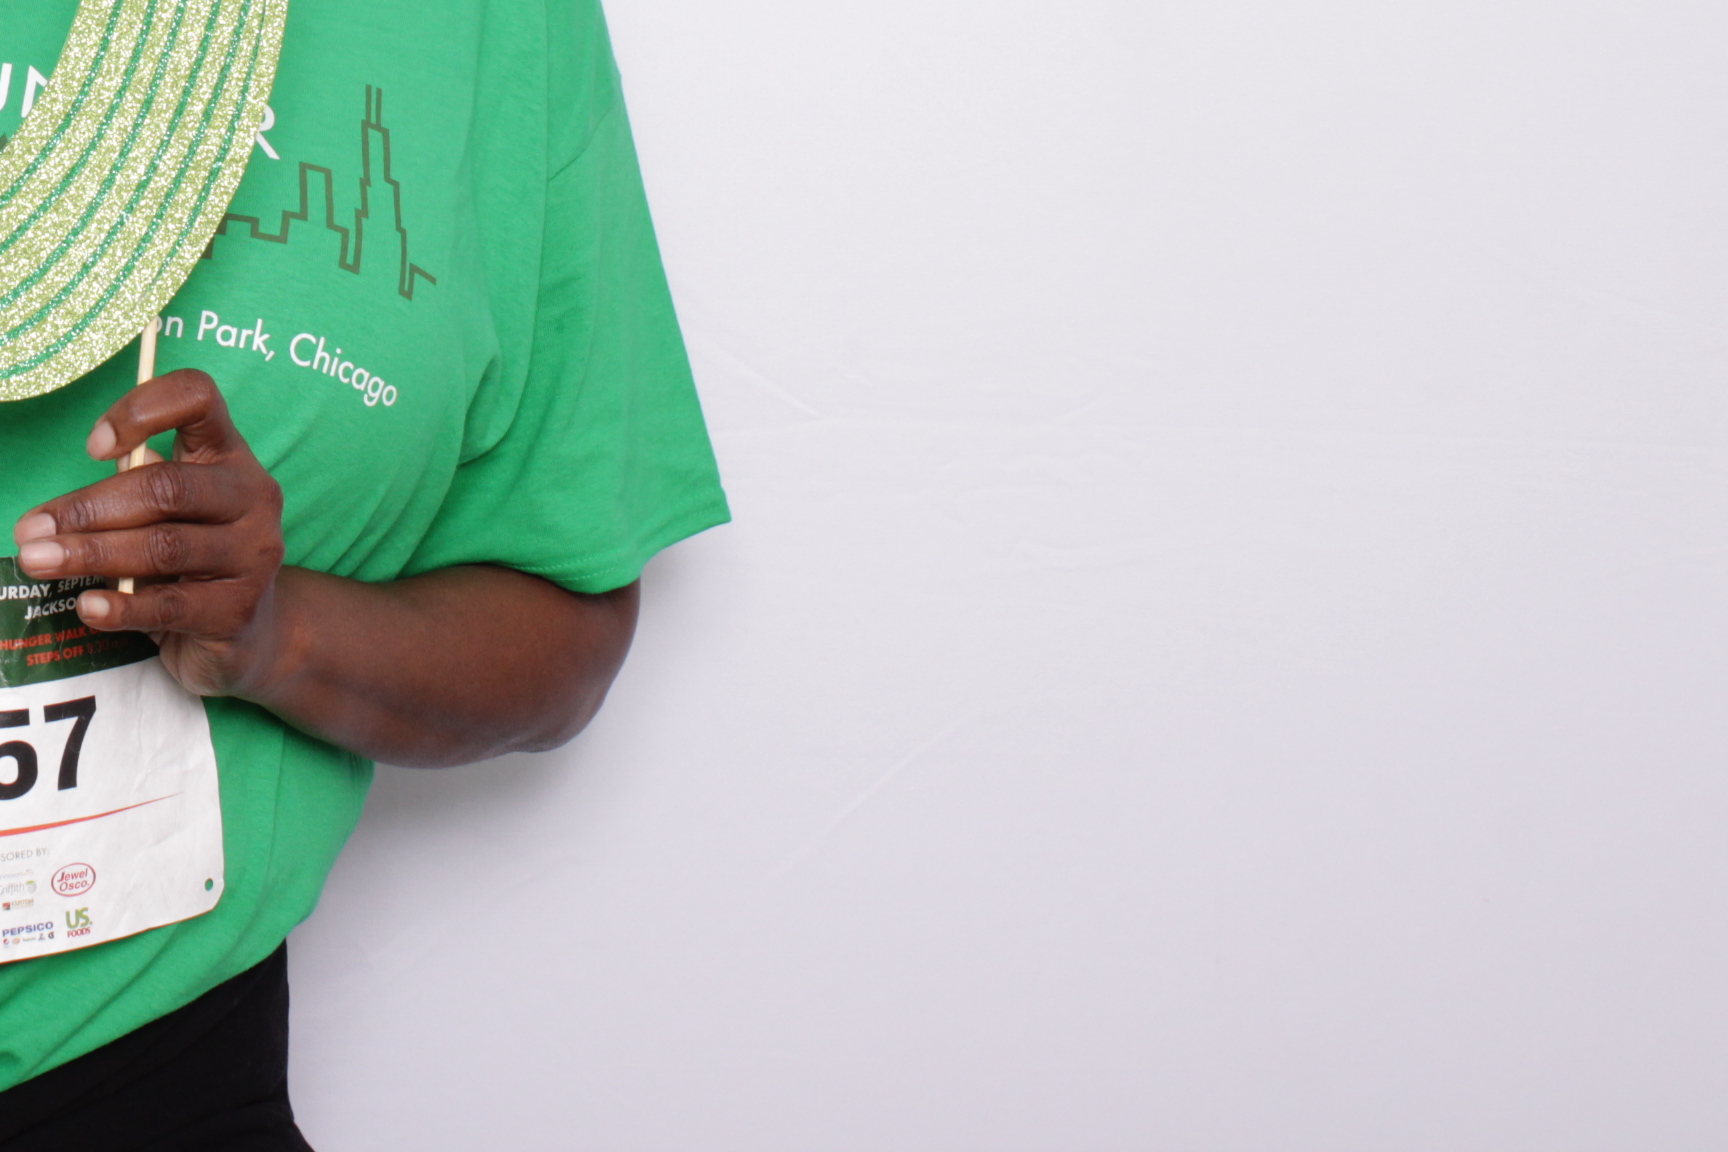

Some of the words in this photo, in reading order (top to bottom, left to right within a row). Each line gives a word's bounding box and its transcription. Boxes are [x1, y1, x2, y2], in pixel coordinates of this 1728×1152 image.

[196, 310, 276, 362] Park,
[288, 332, 398, 407] Chicago
[24, 596, 78, 620] JACKSO
[55, 625, 88, 643] WALK
[26, 649, 61, 667] STEPS
[62, 645, 85, 660] OFF
[56, 867, 89, 883] Jewel
[1, 920, 55, 938] PEPSICO
[66, 926, 92, 939] FOODS
